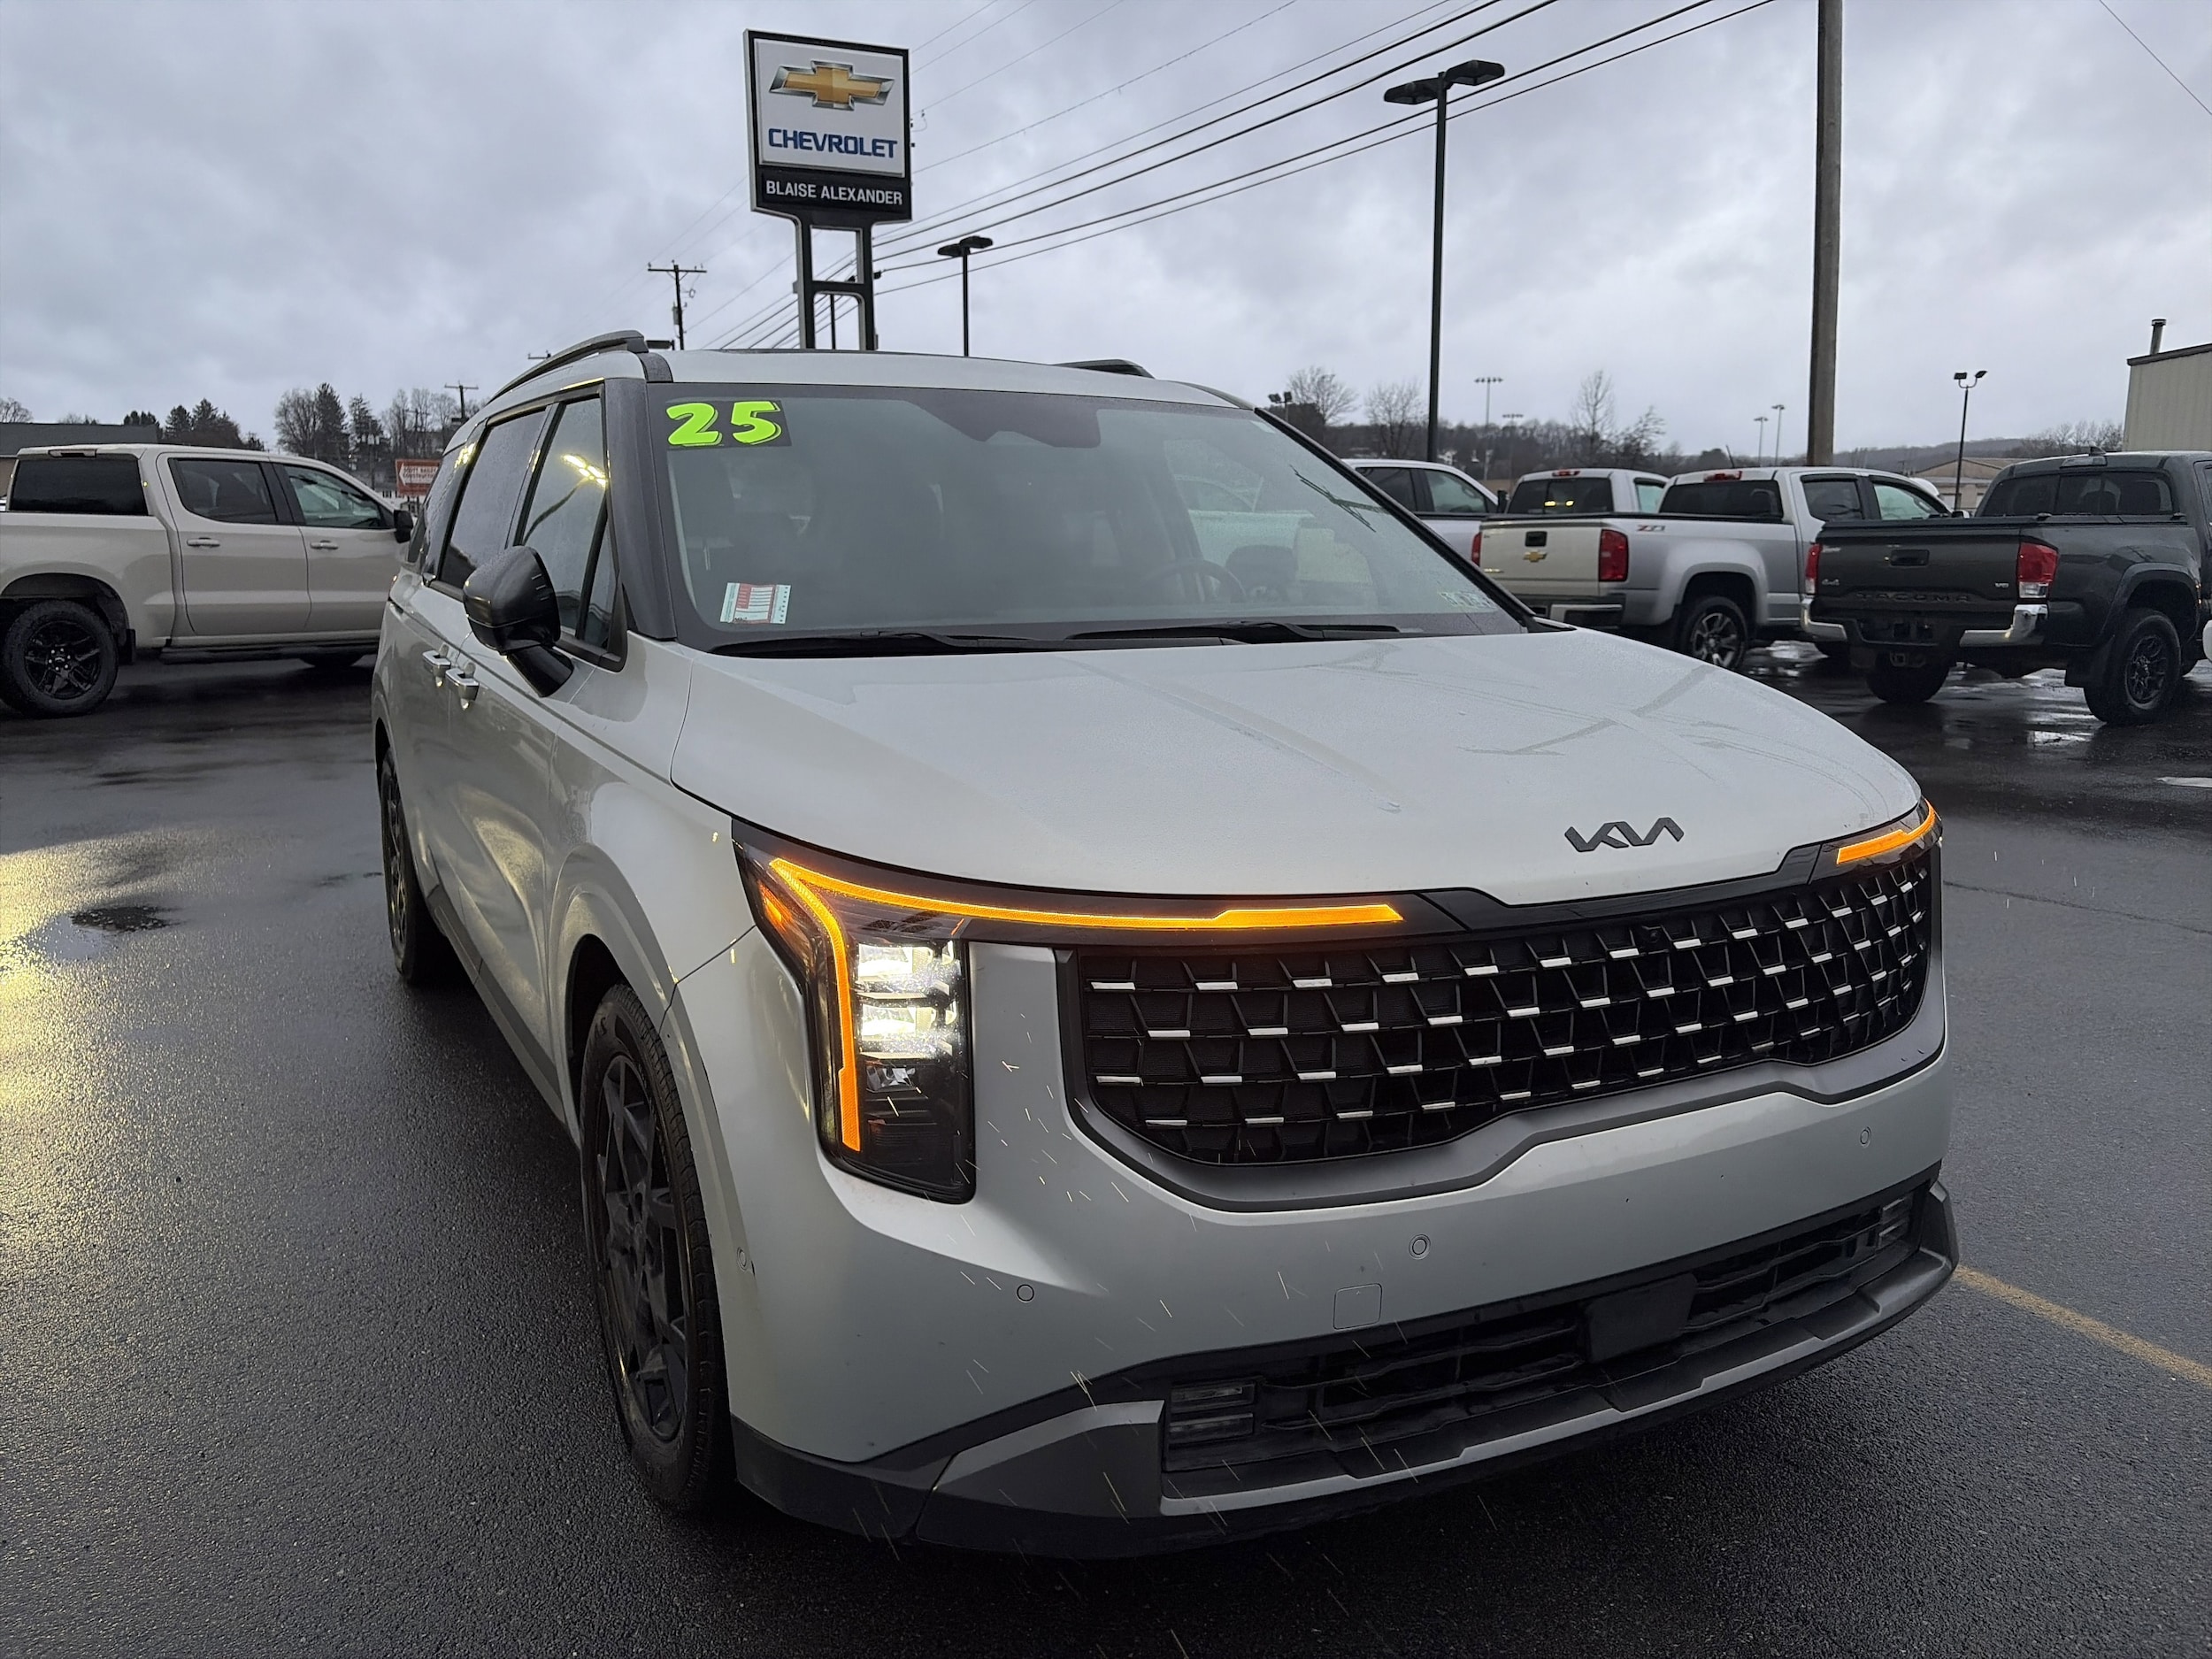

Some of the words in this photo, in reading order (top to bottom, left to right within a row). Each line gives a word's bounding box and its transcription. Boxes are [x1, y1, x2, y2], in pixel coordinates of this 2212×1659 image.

[768, 128, 898, 157] CHEVROLET
[766, 180, 817, 198] BLAISE
[821, 186, 902, 205] ALEXANDER
[666, 401, 782, 446] 25
[1855, 592, 1971, 603] TACOMA
[1564, 817, 1685, 852] KIA
